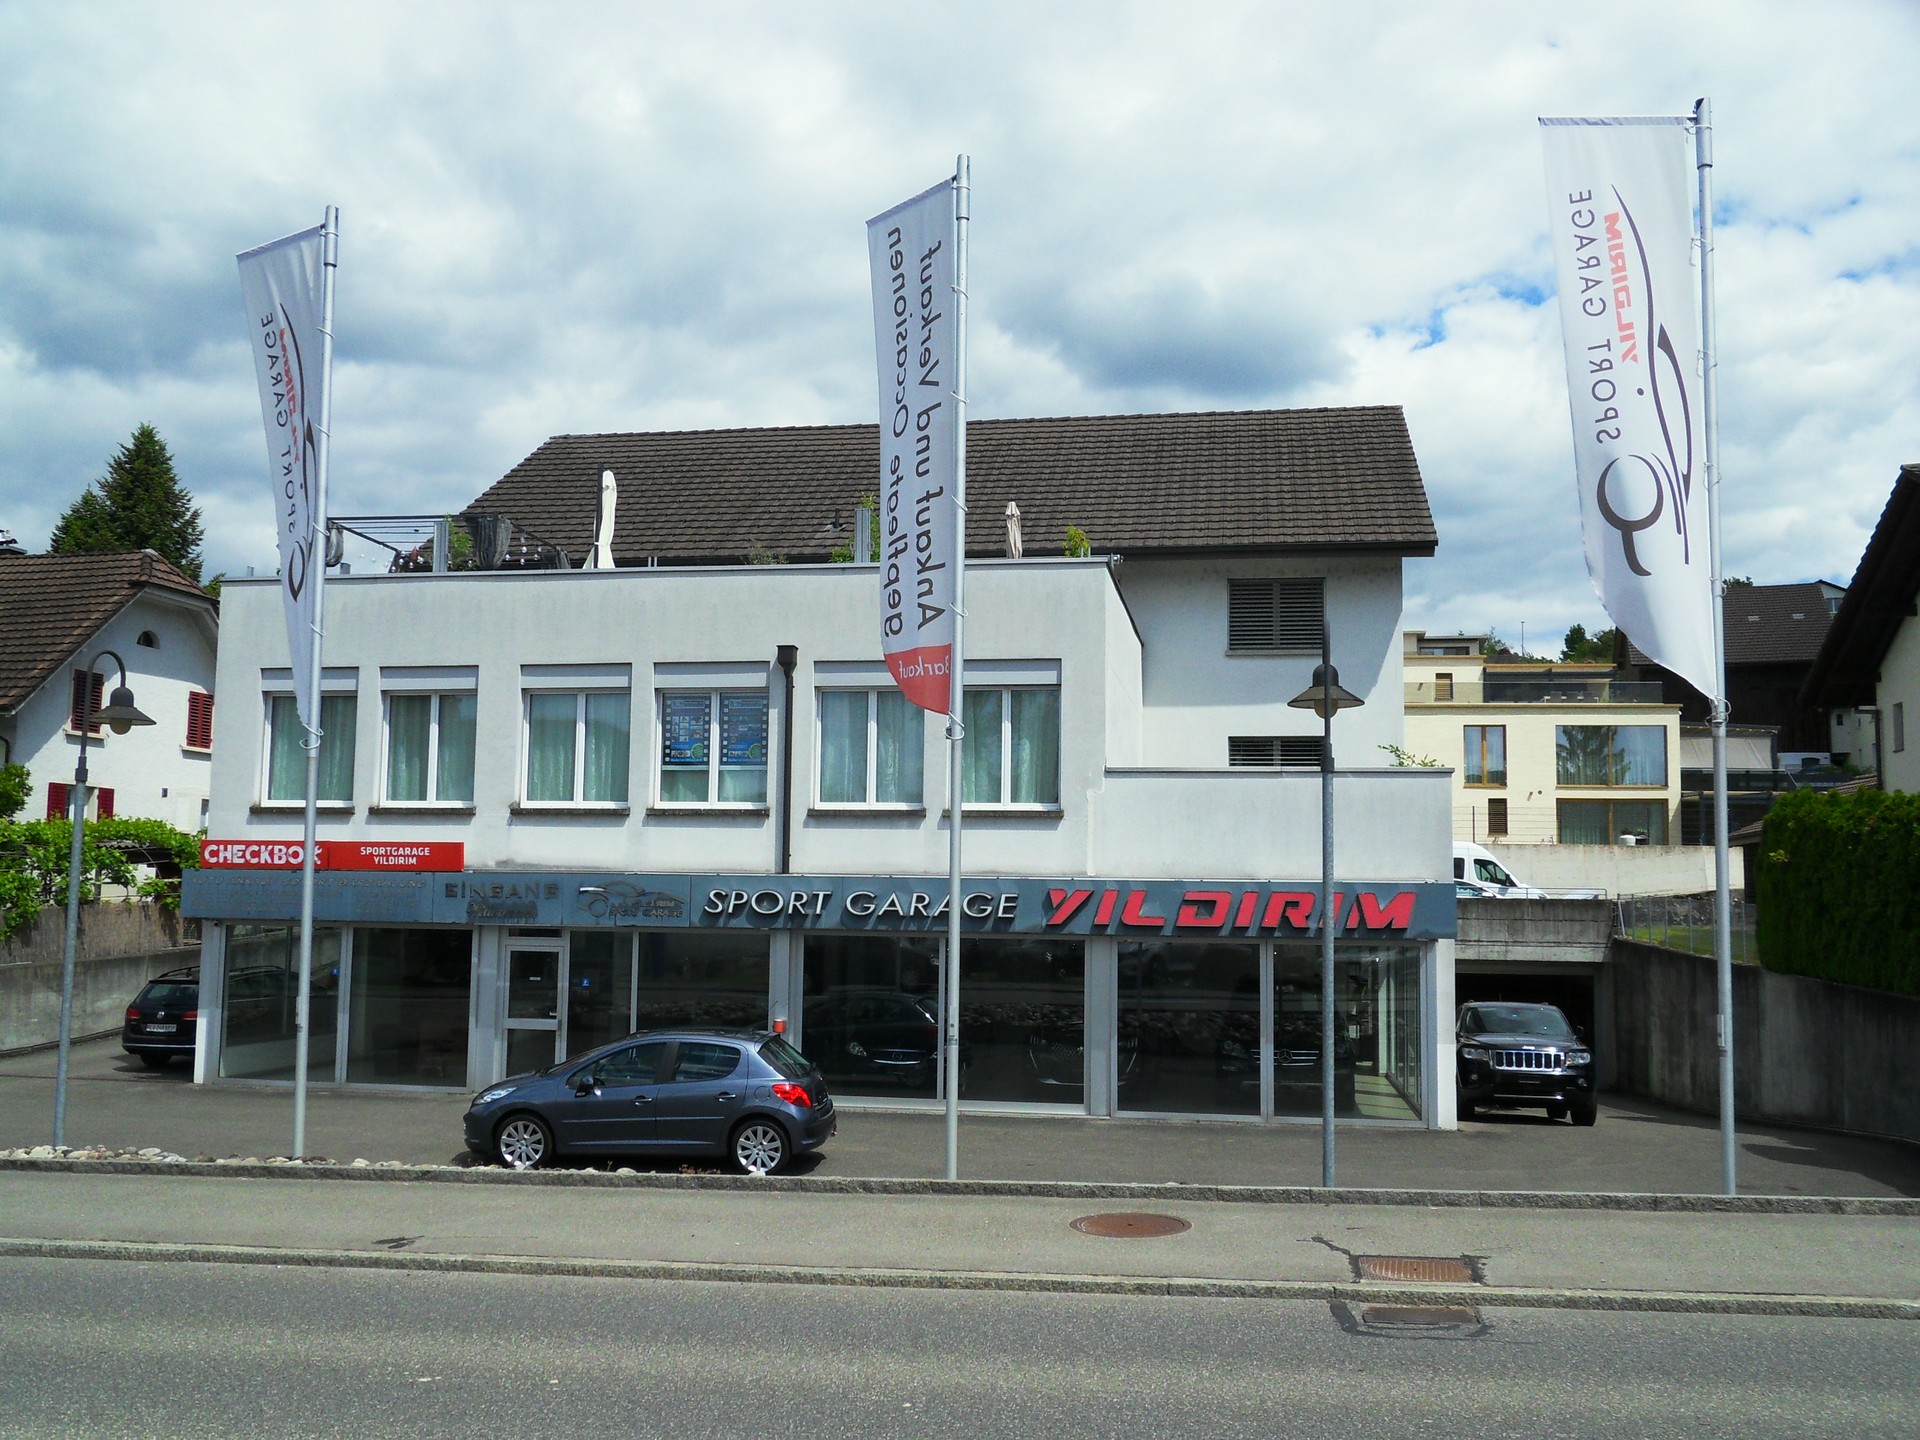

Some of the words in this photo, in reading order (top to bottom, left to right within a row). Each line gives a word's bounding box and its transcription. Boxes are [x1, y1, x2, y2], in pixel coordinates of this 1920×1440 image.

[360, 846, 430, 856] SPORTGARAGE
[373, 856, 417, 865] YILDIRIM
[703, 888, 832, 917] SPORT
[846, 891, 1018, 918] GARAGE
[1046, 888, 1416, 929] YILDIRIM
